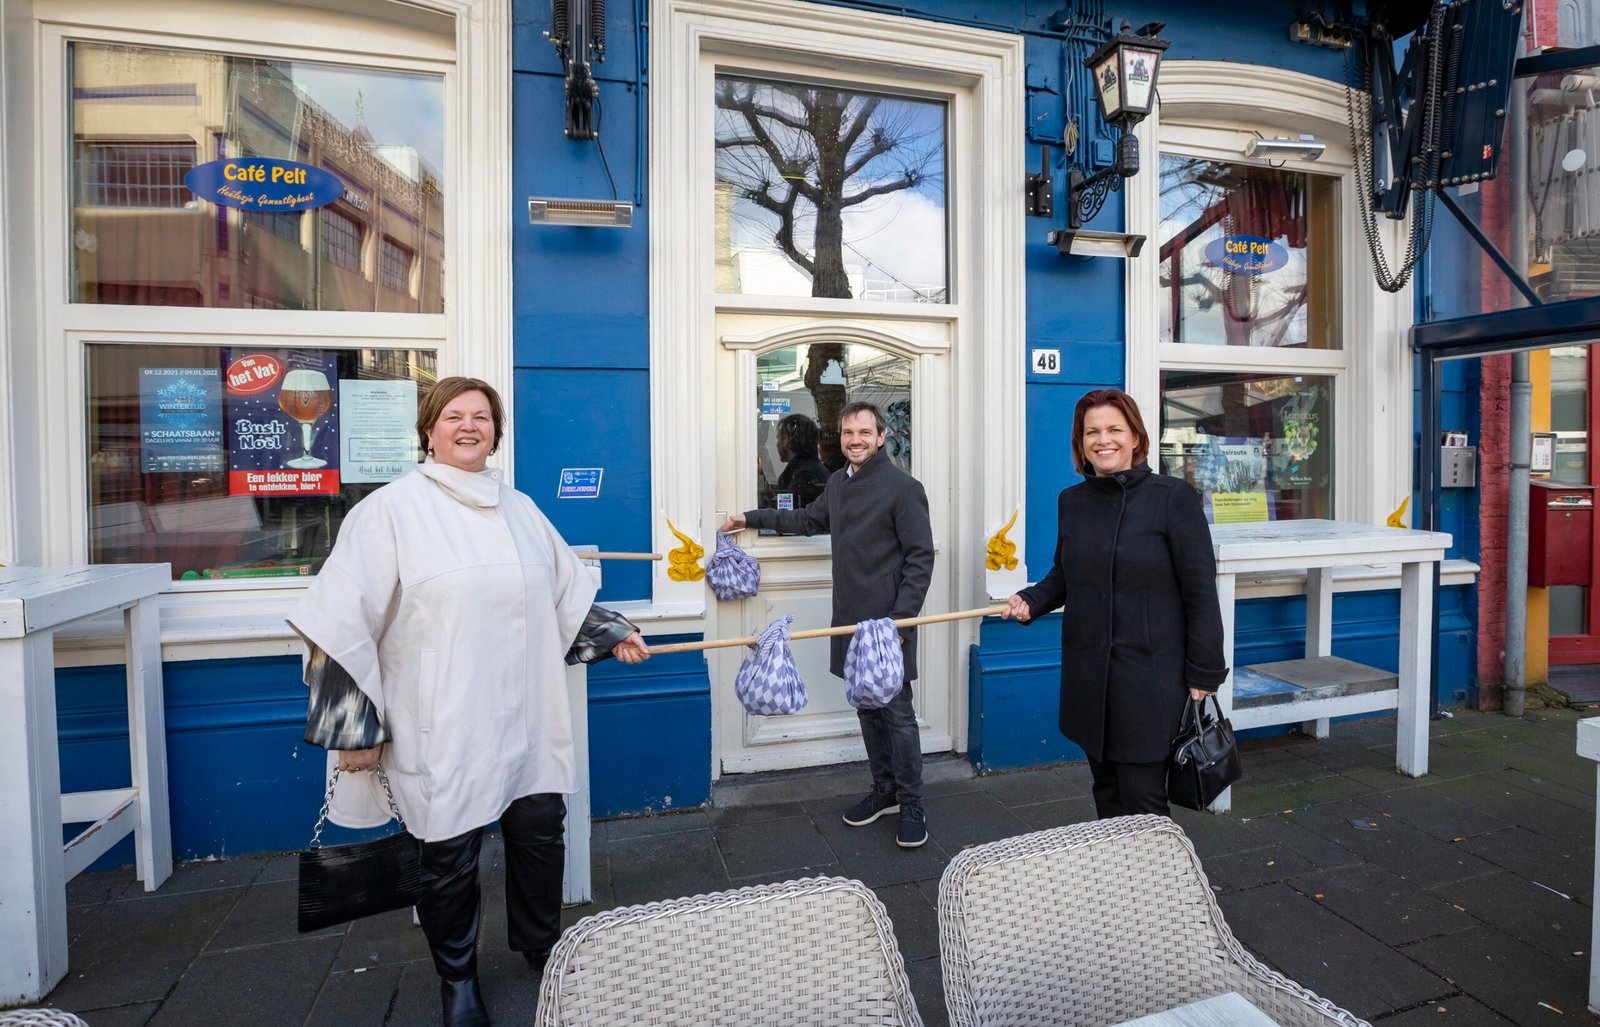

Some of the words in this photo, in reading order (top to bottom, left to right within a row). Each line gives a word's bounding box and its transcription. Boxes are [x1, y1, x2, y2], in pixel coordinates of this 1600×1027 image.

[223, 163, 266, 183] Café
[271, 166, 307, 184] Pelt
[1225, 240, 1248, 254] Café
[1250, 242, 1269, 254] Pelt
[241, 358, 256, 368] Van
[1037, 353, 1056, 370] 48
[229, 369, 254, 387] het
[252, 362, 277, 379] Vat
[151, 430, 215, 438] SCHAATSBAAN
[235, 419, 286, 435] Bush
[247, 473, 265, 483] Een
[267, 472, 299, 482] lekker
[301, 472, 322, 482] bier
[258, 483, 299, 492] ontdekken,
